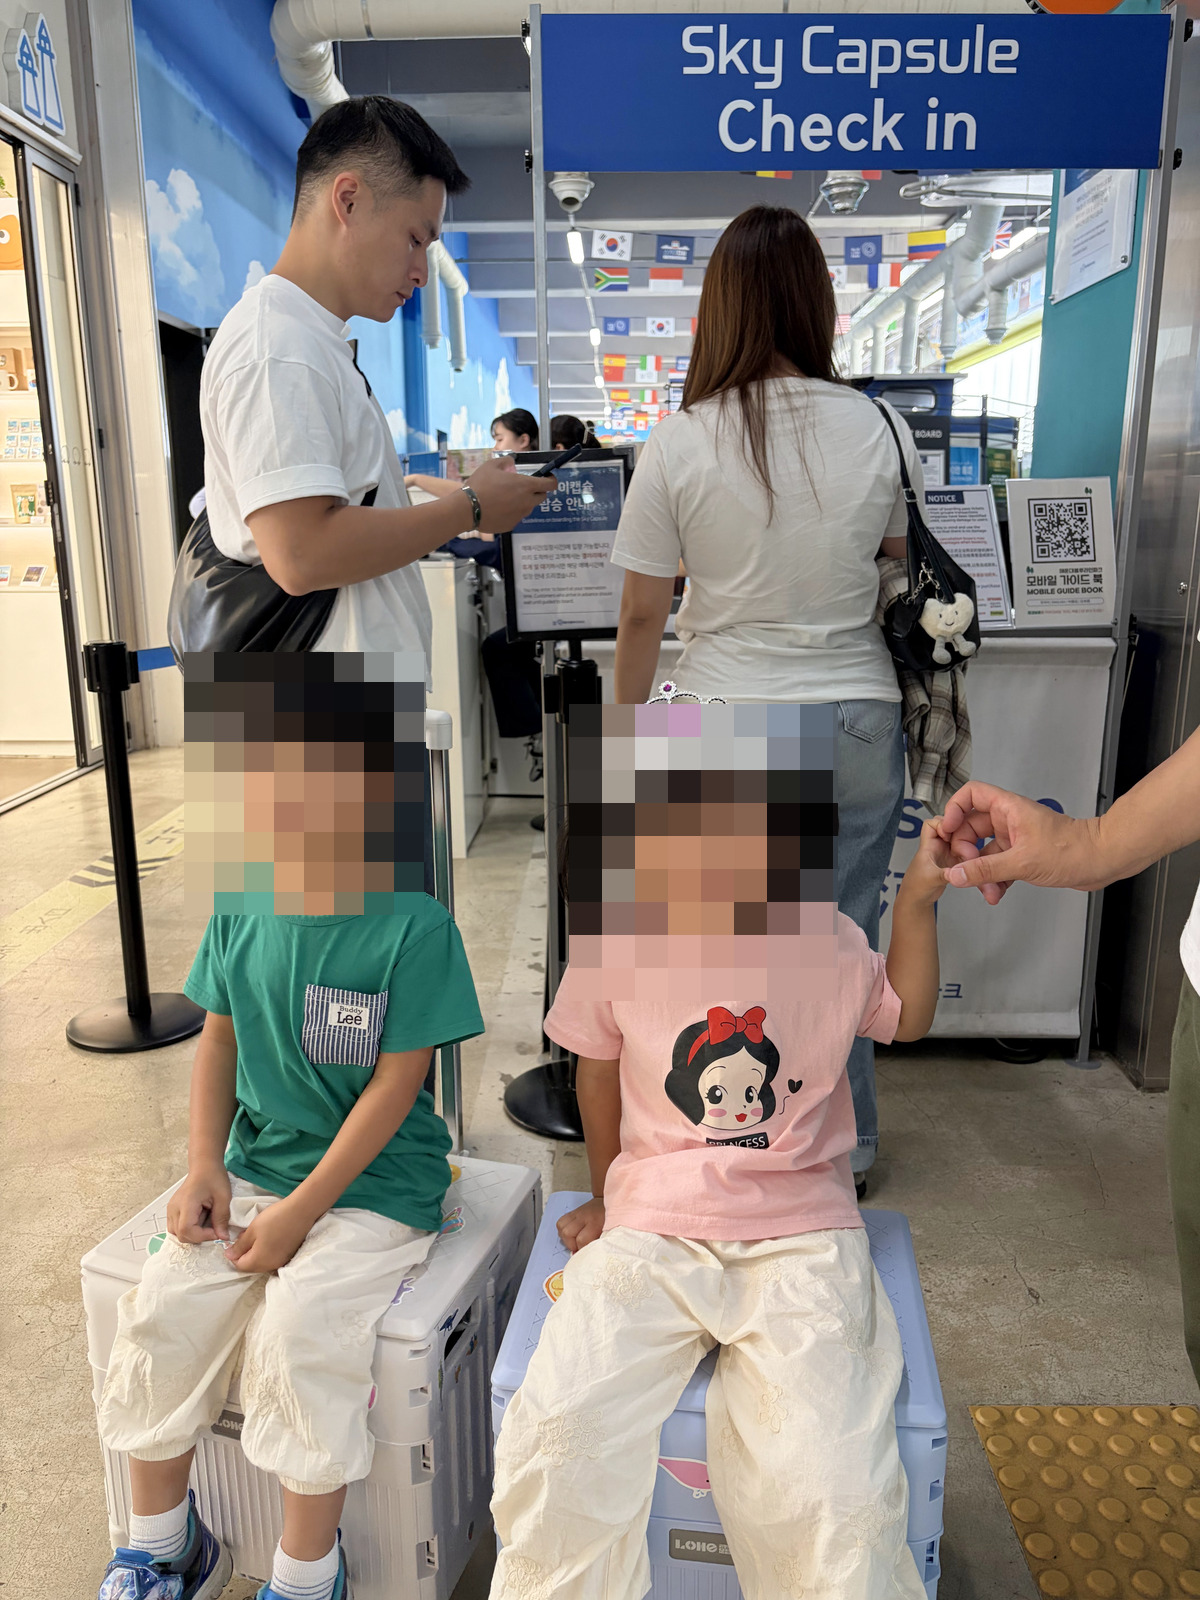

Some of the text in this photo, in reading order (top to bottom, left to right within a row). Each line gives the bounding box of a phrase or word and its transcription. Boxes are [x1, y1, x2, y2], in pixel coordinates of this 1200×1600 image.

[681, 24, 1020, 90] Sky Capsule
[718, 97, 977, 153] Check in
[915, 429, 942, 438] BOARD
[546, 481, 594, 495] 이캡슐
[927, 495, 957, 503] NOTICE
[1026, 574, 1103, 587] 모바일 가이드 북
[1057, 587, 1080, 595] GUIDE
[939, 983, 963, 999] 크
[340, 1006, 364, 1015] Buddy
[337, 1012, 363, 1025] Lee
[709, 1136, 766, 1148] NCESS
